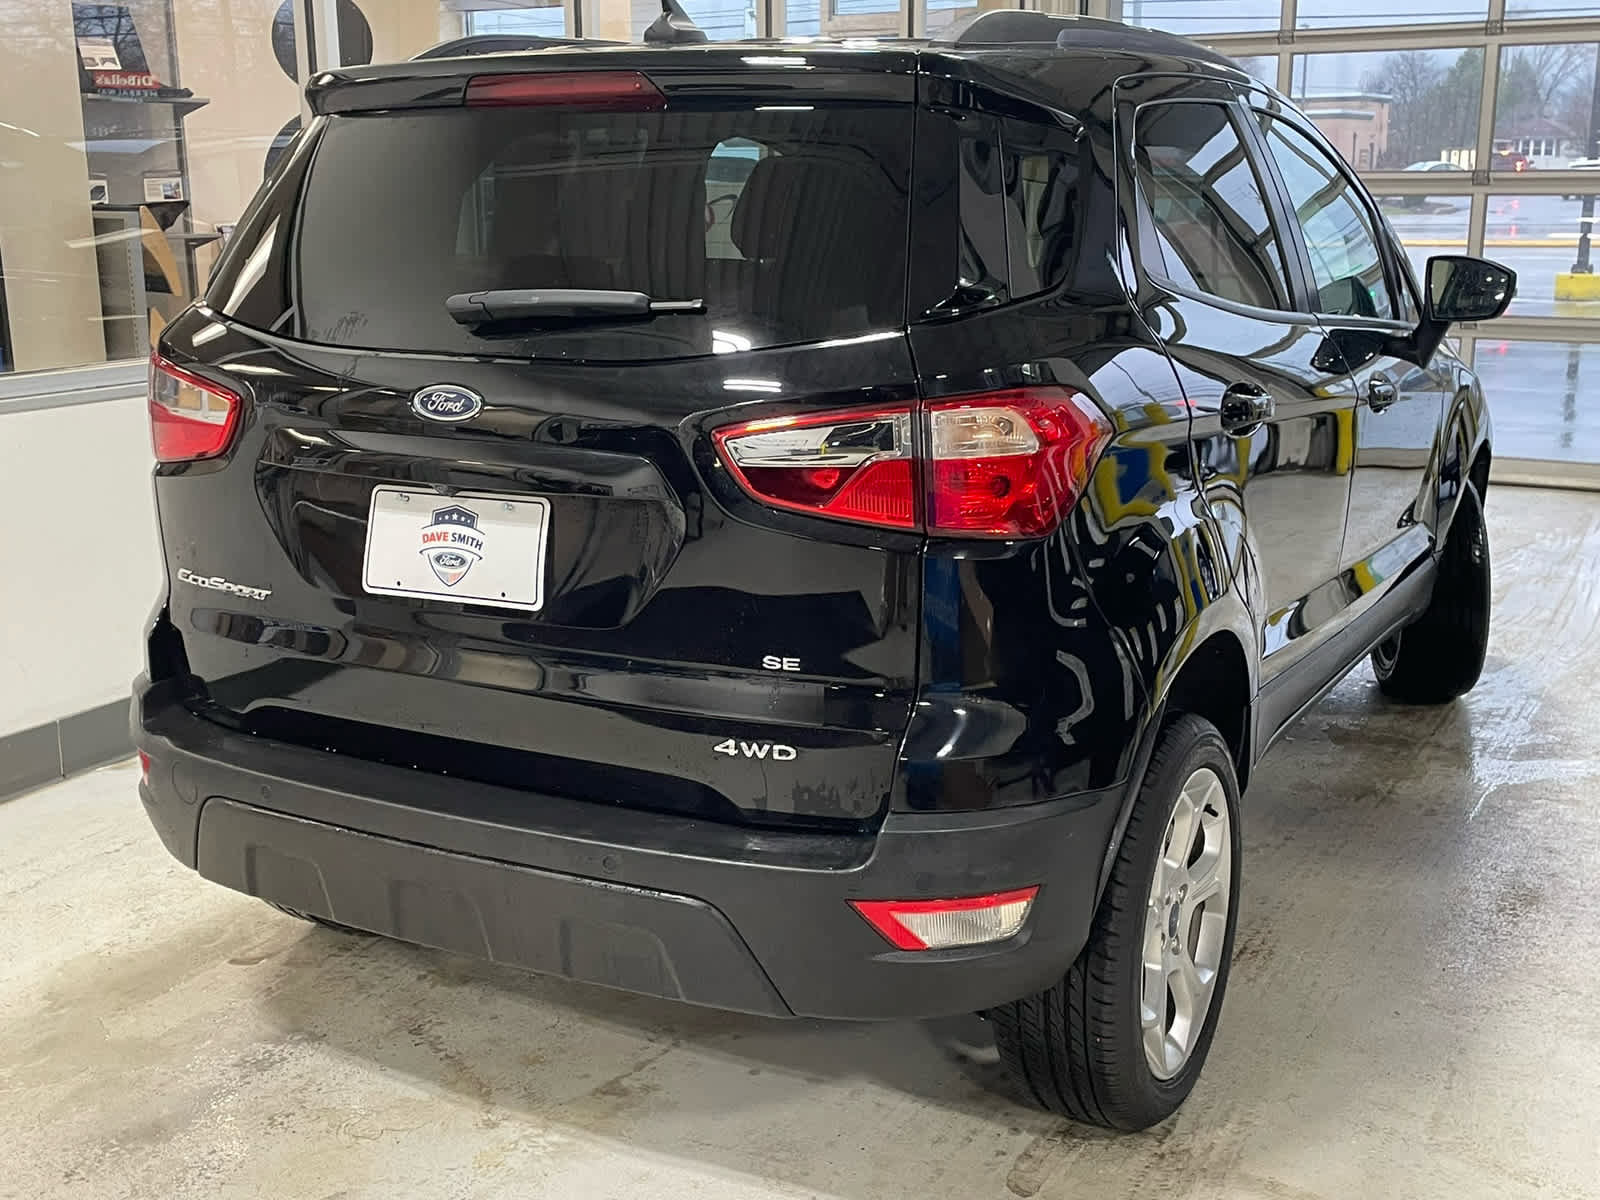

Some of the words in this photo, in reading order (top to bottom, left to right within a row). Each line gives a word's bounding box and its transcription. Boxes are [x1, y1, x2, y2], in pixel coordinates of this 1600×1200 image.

[427, 391, 466, 413] Ford
[422, 531, 449, 544] DAVE
[451, 532, 483, 551] SMITH
[762, 655, 801, 671] SE
[713, 738, 797, 761] 4WD
